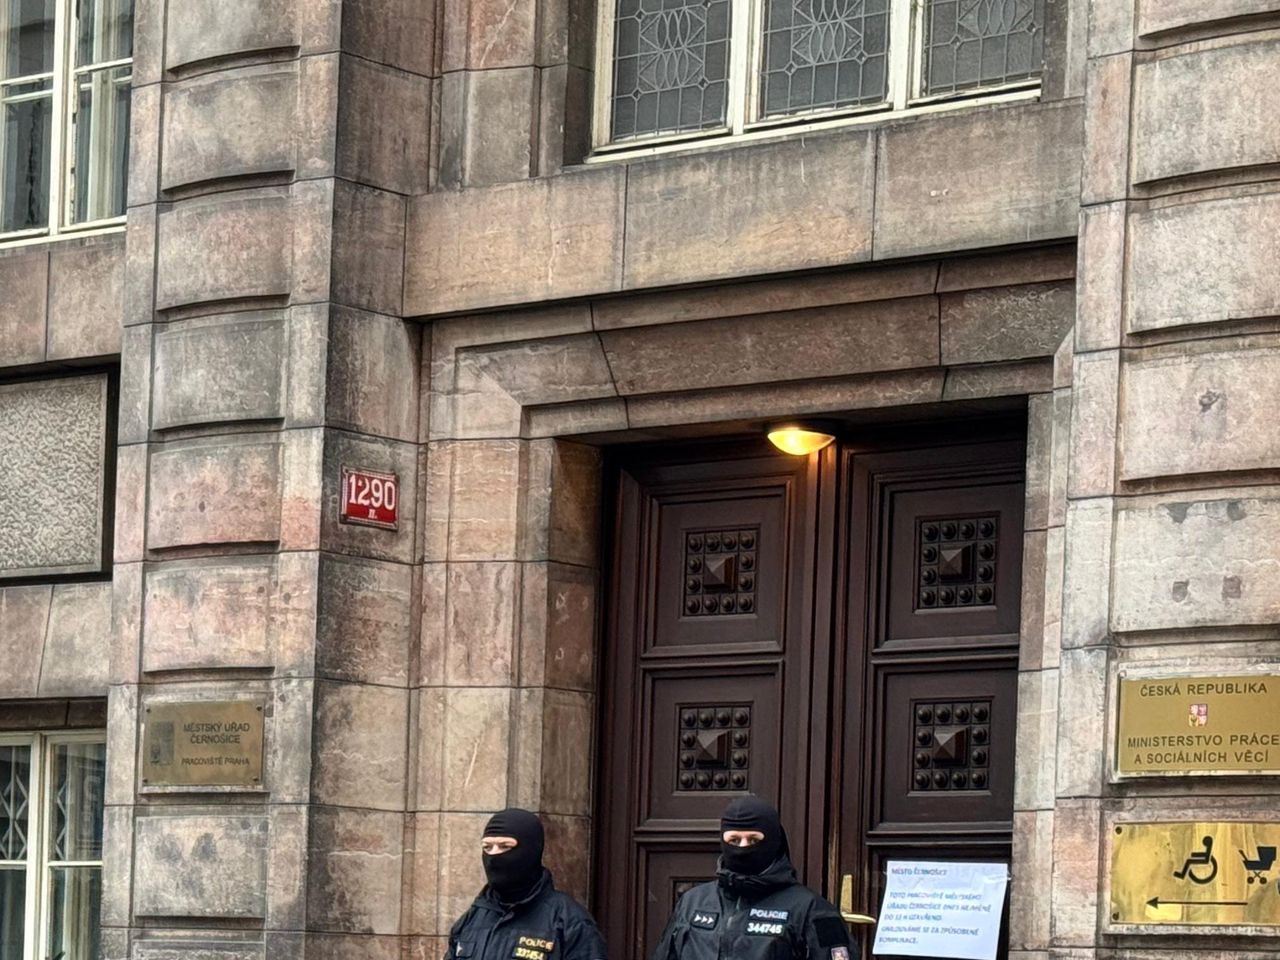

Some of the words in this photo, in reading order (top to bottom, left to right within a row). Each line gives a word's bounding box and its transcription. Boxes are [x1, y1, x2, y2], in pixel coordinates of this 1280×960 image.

[349, 475, 395, 510] 1290
[1140, 682, 1181, 697] ČESKÁ
[1187, 682, 1268, 695] REPUBLIKA
[190, 734, 240, 744] ČERNOŠICE
[1127, 734, 1223, 748] MINISTERSTVO
[1229, 732, 1280, 746] PRÁCE
[224, 757, 250, 766] PRAHA
[1134, 754, 1142, 764] A
[1146, 750, 1227, 764] SOCIÁLNÍCH
[1234, 749, 1269, 763] VĚCÍ
[749, 908, 789, 920] POLICIE
